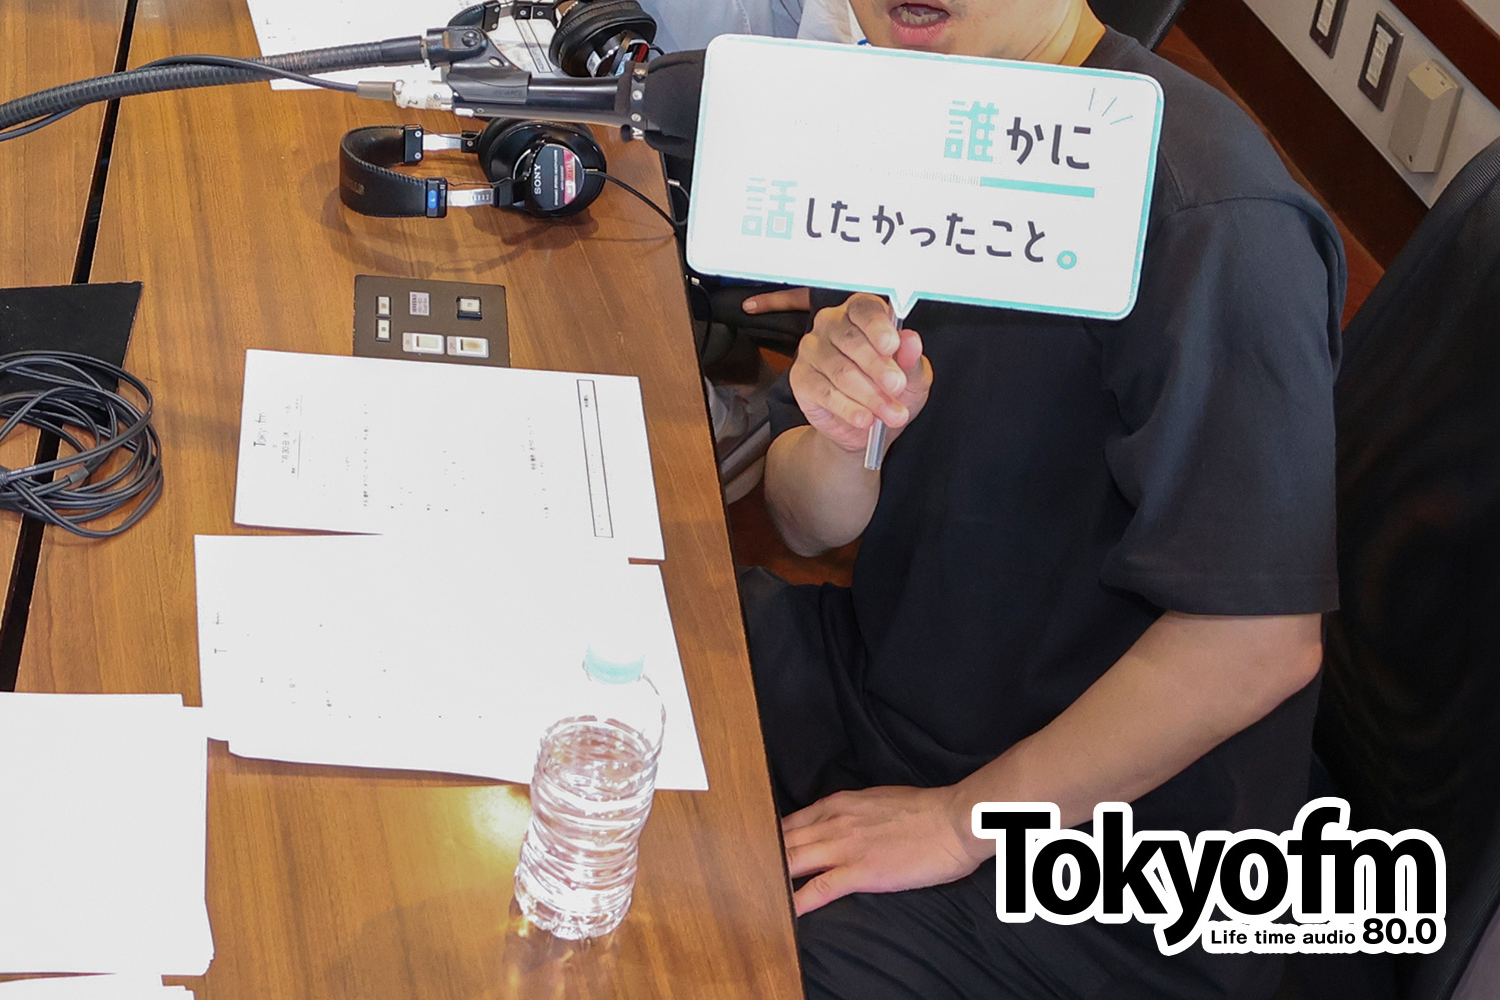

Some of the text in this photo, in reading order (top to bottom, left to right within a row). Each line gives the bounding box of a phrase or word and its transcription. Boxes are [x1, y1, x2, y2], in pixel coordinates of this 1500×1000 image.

[943, 100, 1092, 170] 誰かに
[534, 162, 542, 196] SONY
[741, 177, 1078, 270] 話したかったこと。
